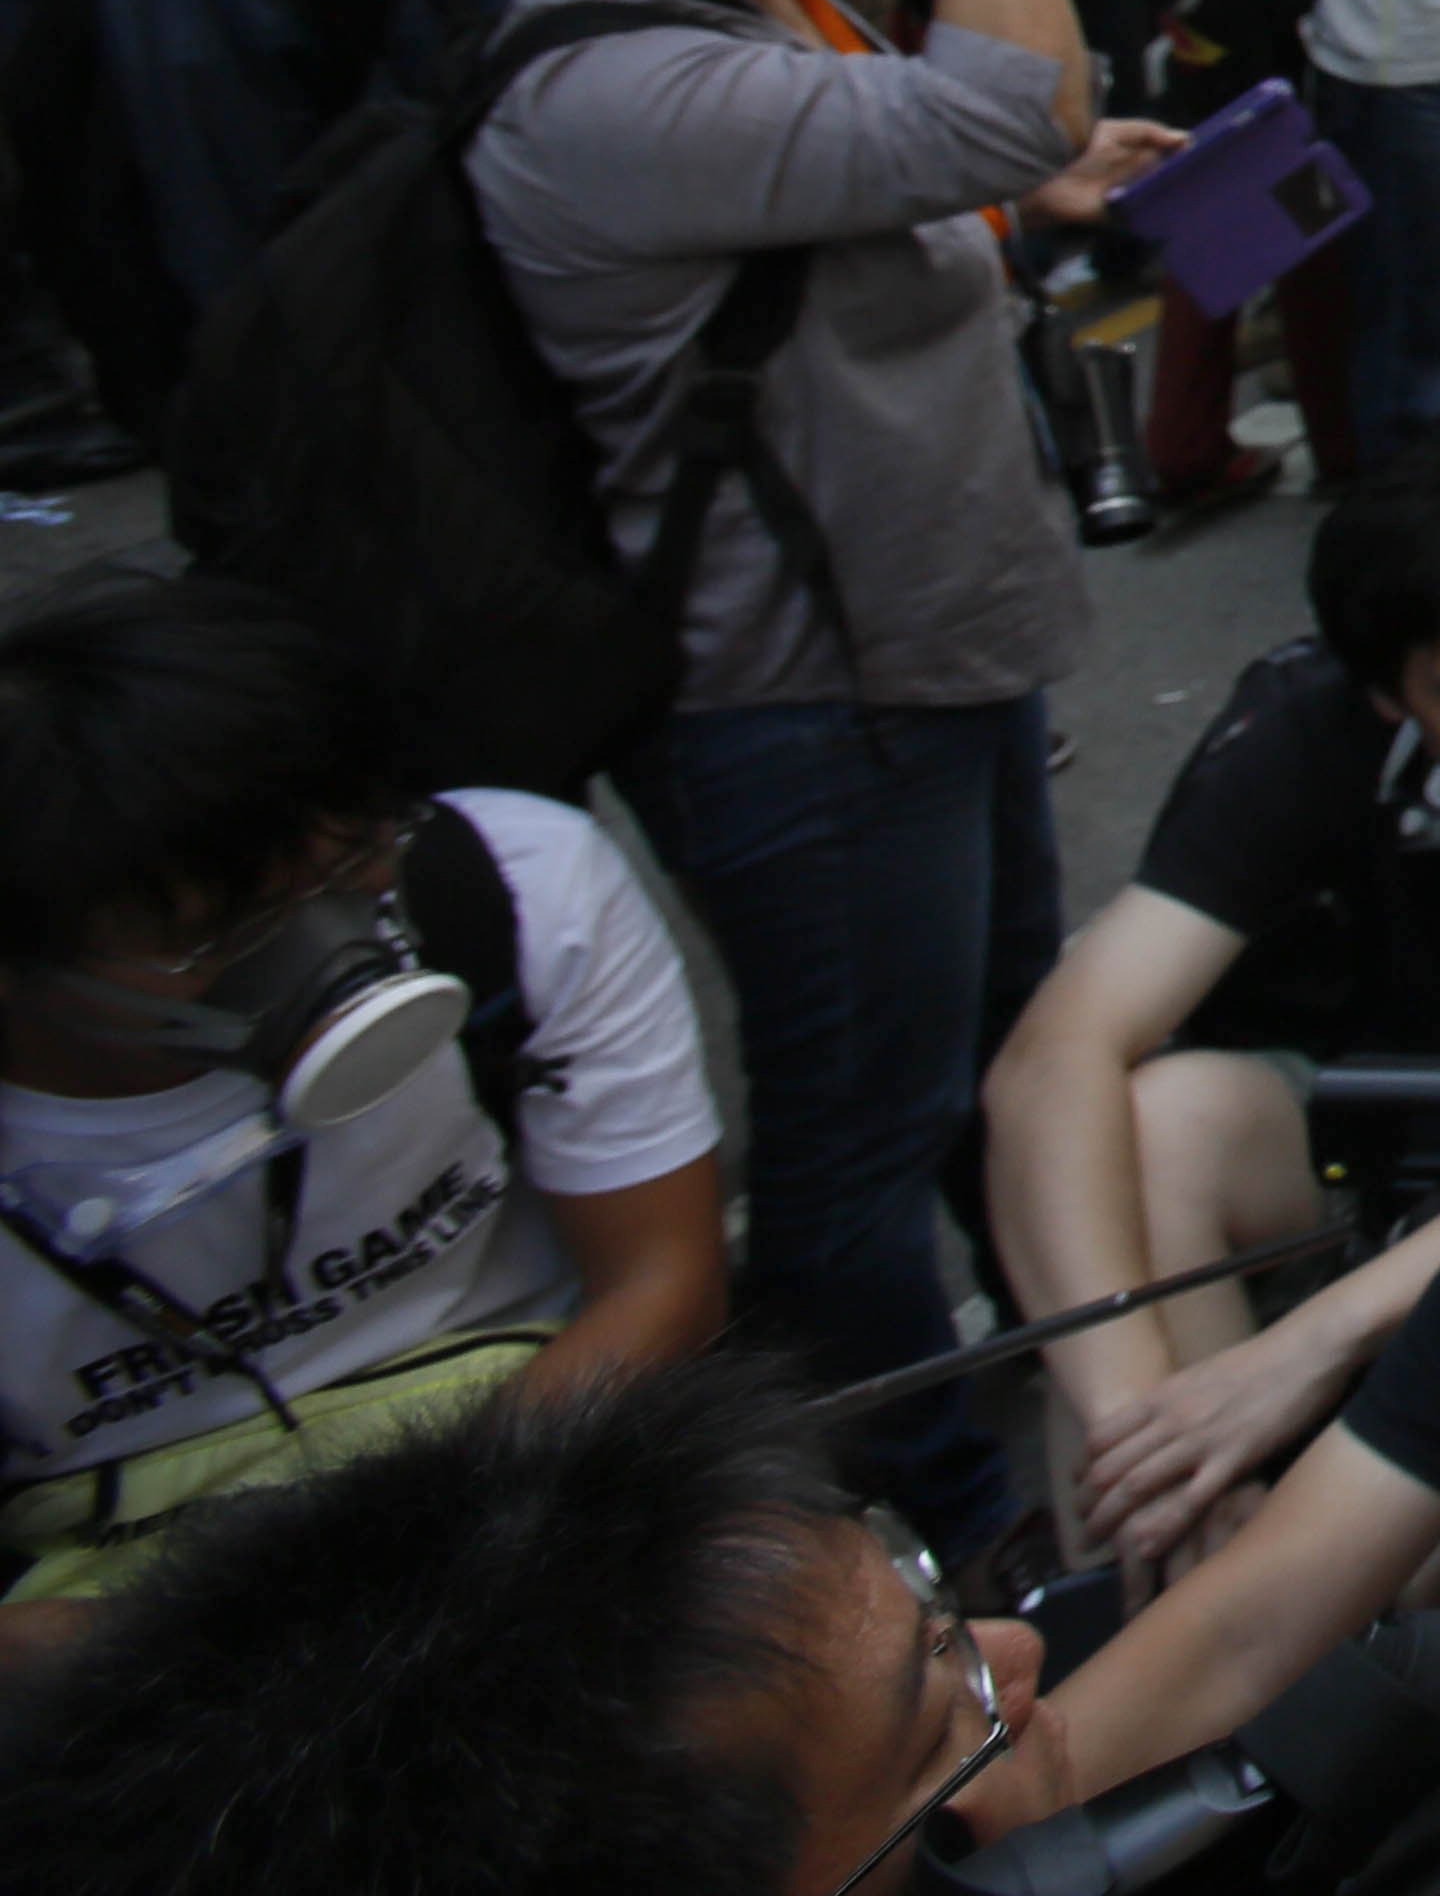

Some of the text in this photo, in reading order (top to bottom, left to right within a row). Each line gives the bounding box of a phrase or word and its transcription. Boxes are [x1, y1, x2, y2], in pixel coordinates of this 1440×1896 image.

[74, 1161, 466, 1401] FRSH GAME
[350, 1241, 436, 1300] THIS
[435, 1175, 505, 1246] LINE
